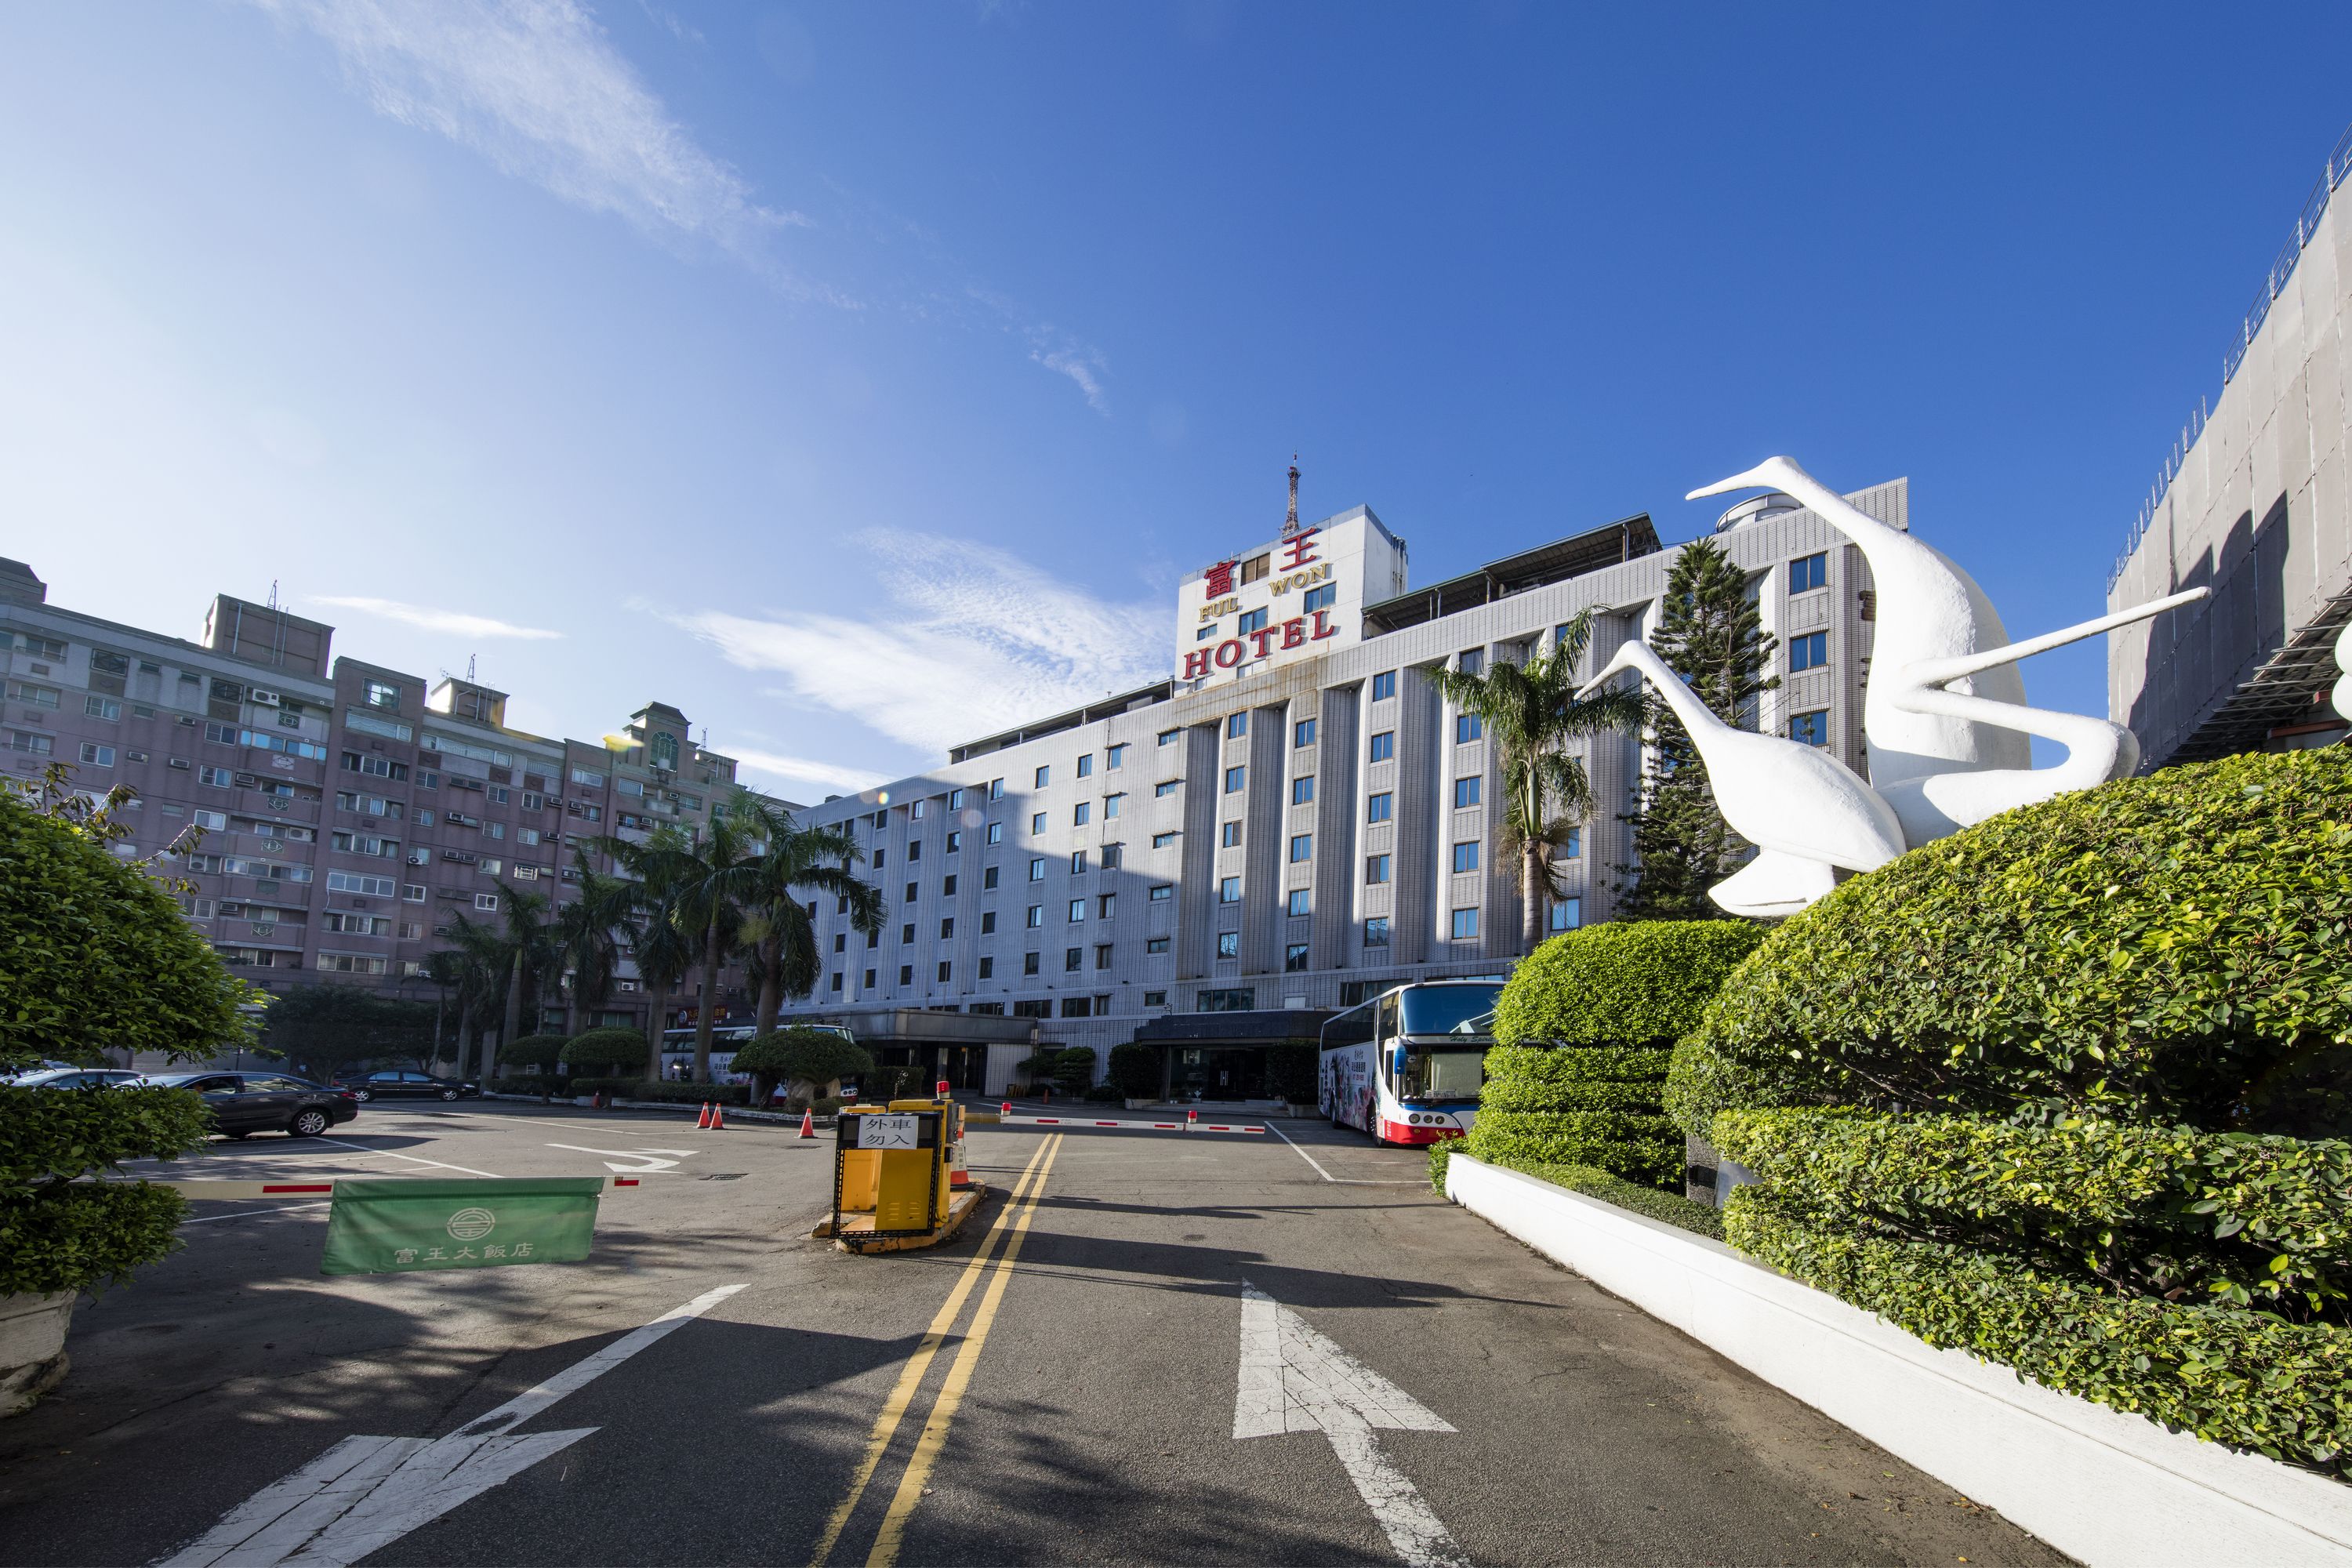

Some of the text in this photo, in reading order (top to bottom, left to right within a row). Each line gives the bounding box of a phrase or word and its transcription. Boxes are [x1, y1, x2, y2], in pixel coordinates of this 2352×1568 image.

[1203, 527, 1317, 600] 富王
[1198, 562, 1330, 622] FUL WON
[1182, 610, 1335, 680] HOTEL
[865, 1134, 910, 1145] 勿入
[866, 1119, 912, 1131] 外車
[394, 1243, 535, 1264] 富王大飯店
